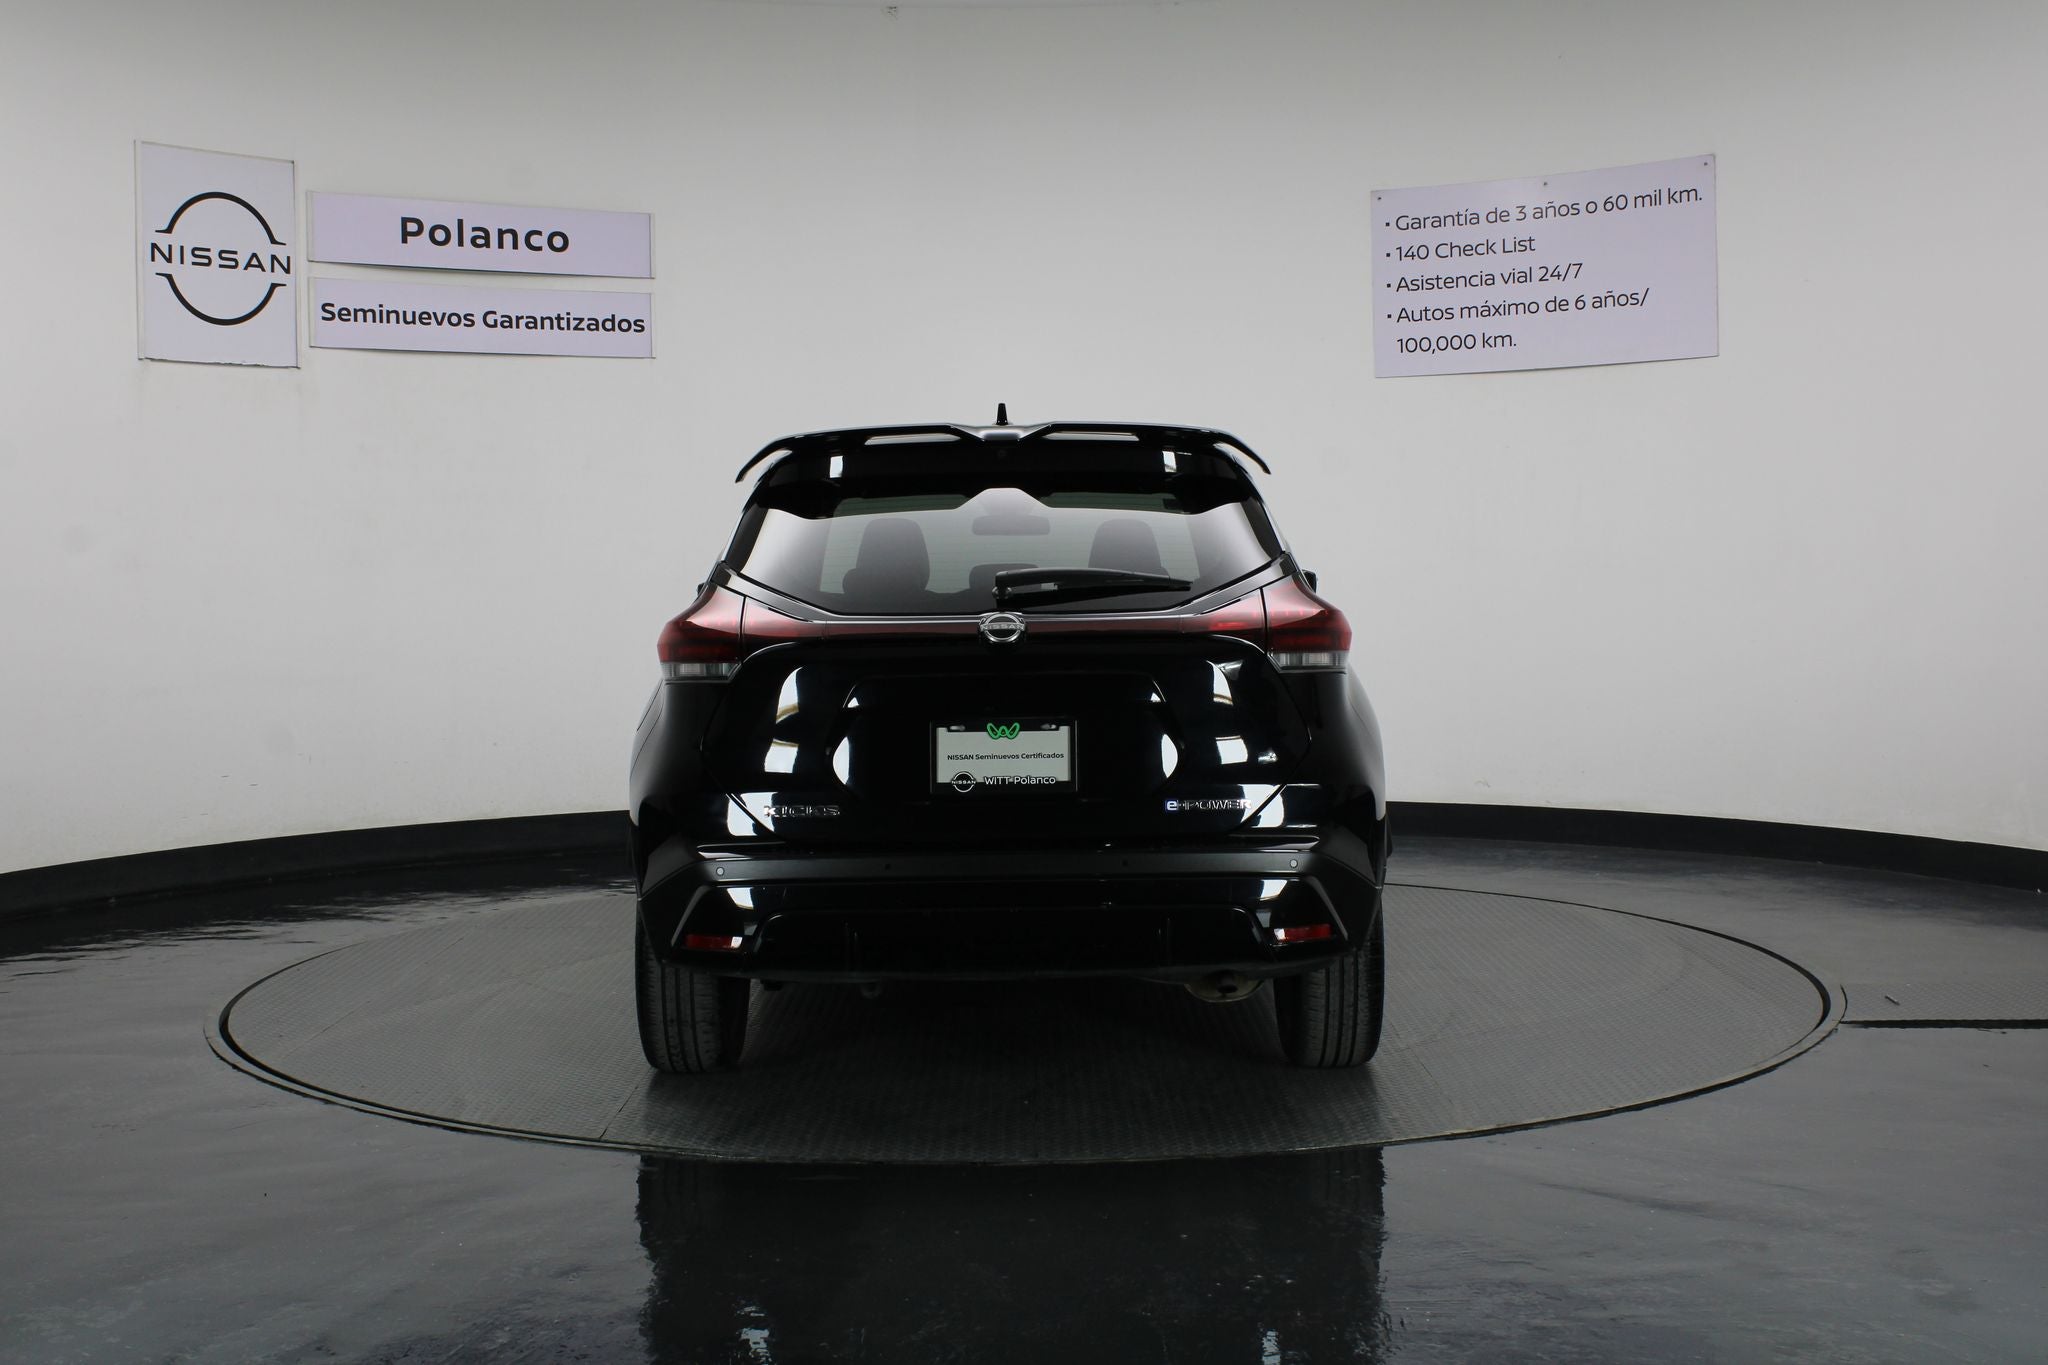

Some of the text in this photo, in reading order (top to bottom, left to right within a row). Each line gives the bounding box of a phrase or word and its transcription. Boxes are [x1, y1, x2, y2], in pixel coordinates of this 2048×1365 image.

[1395, 186, 1702, 232] Garantía de 3 años o 60 mil km.
[400, 216, 570, 253] Polanco
[1396, 236, 1536, 261] 140 Check List
[151, 242, 291, 275] NISSAN
[1396, 263, 1583, 293] Asistencia vial 24/7
[320, 302, 645, 333] Seminuevos Garantizados
[1397, 288, 1649, 323] Autos máximo de 6 años/
[1397, 332, 1517, 355] 100,000 km.
[984, 775, 1056, 785] WITT Polanco
